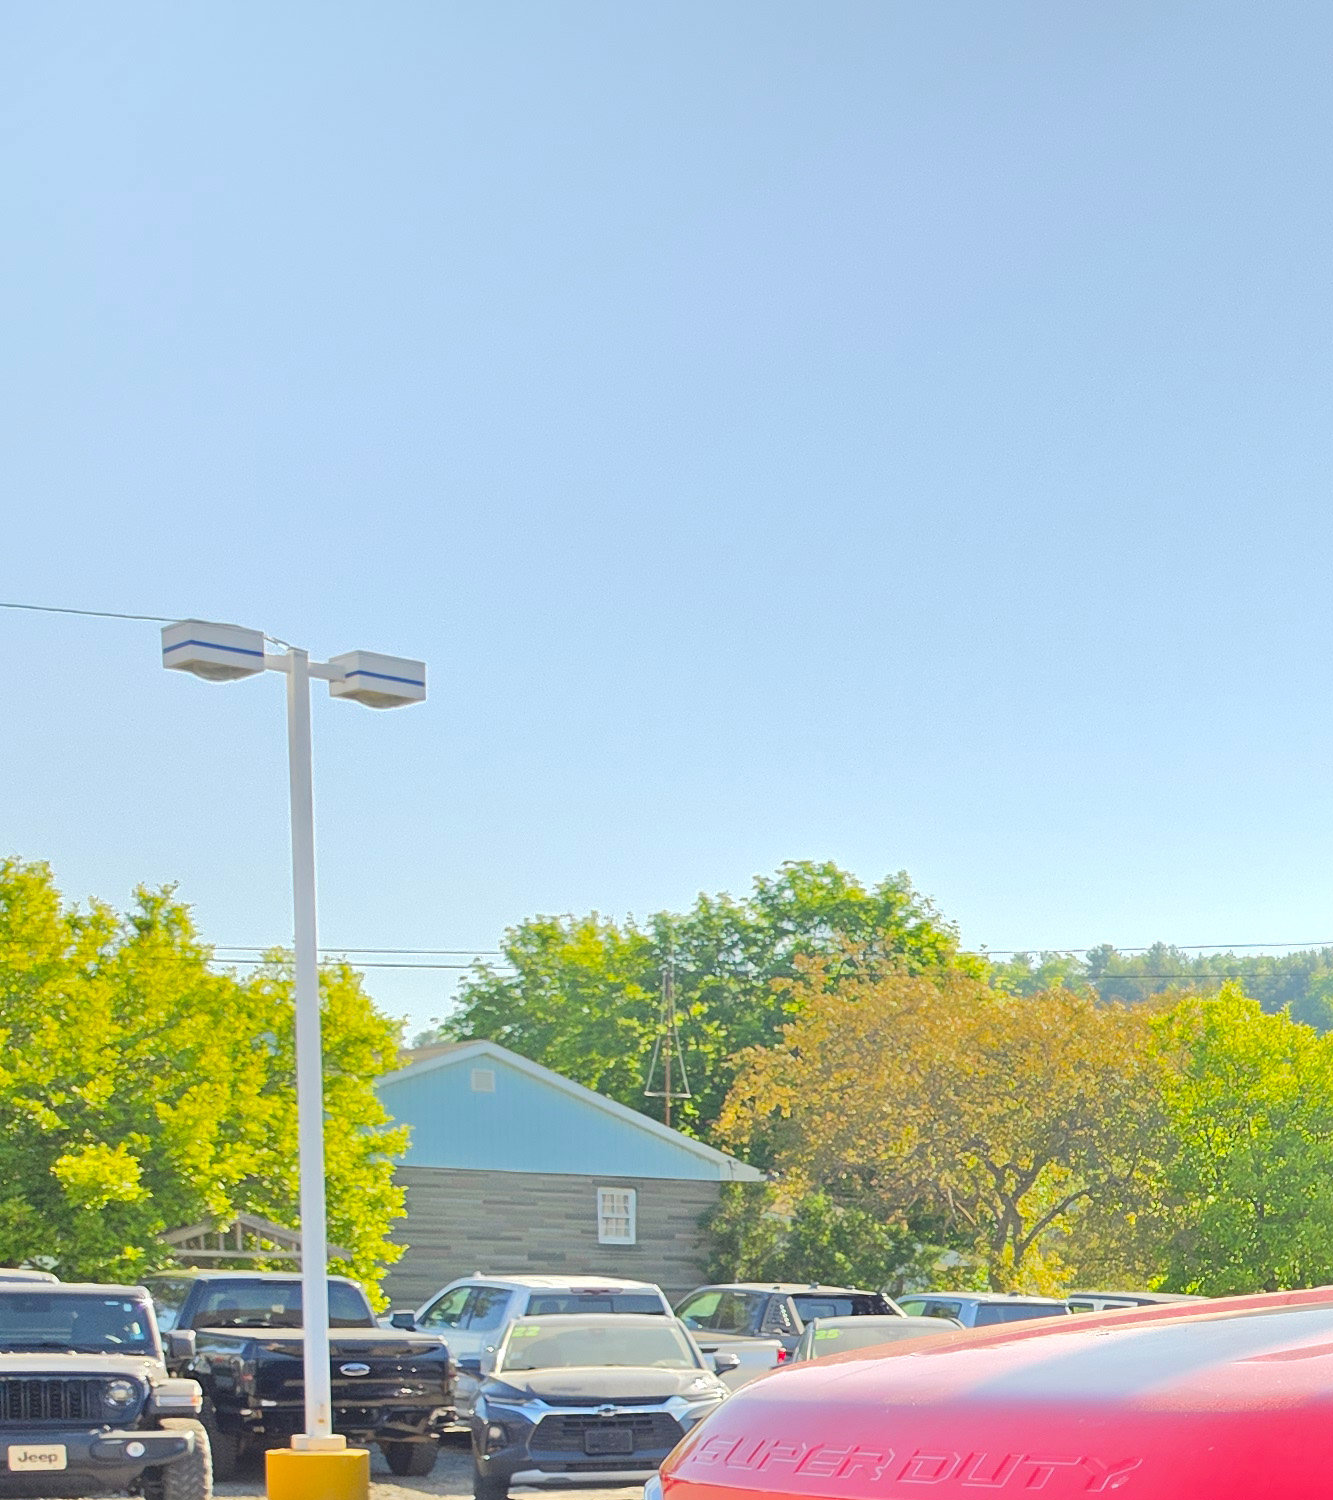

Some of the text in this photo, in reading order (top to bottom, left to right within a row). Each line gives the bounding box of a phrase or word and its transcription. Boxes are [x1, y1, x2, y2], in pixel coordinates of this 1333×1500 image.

[17, 1451, 59, 1464] Jeep
[690, 1434, 1144, 1493] SUPER DUTY
